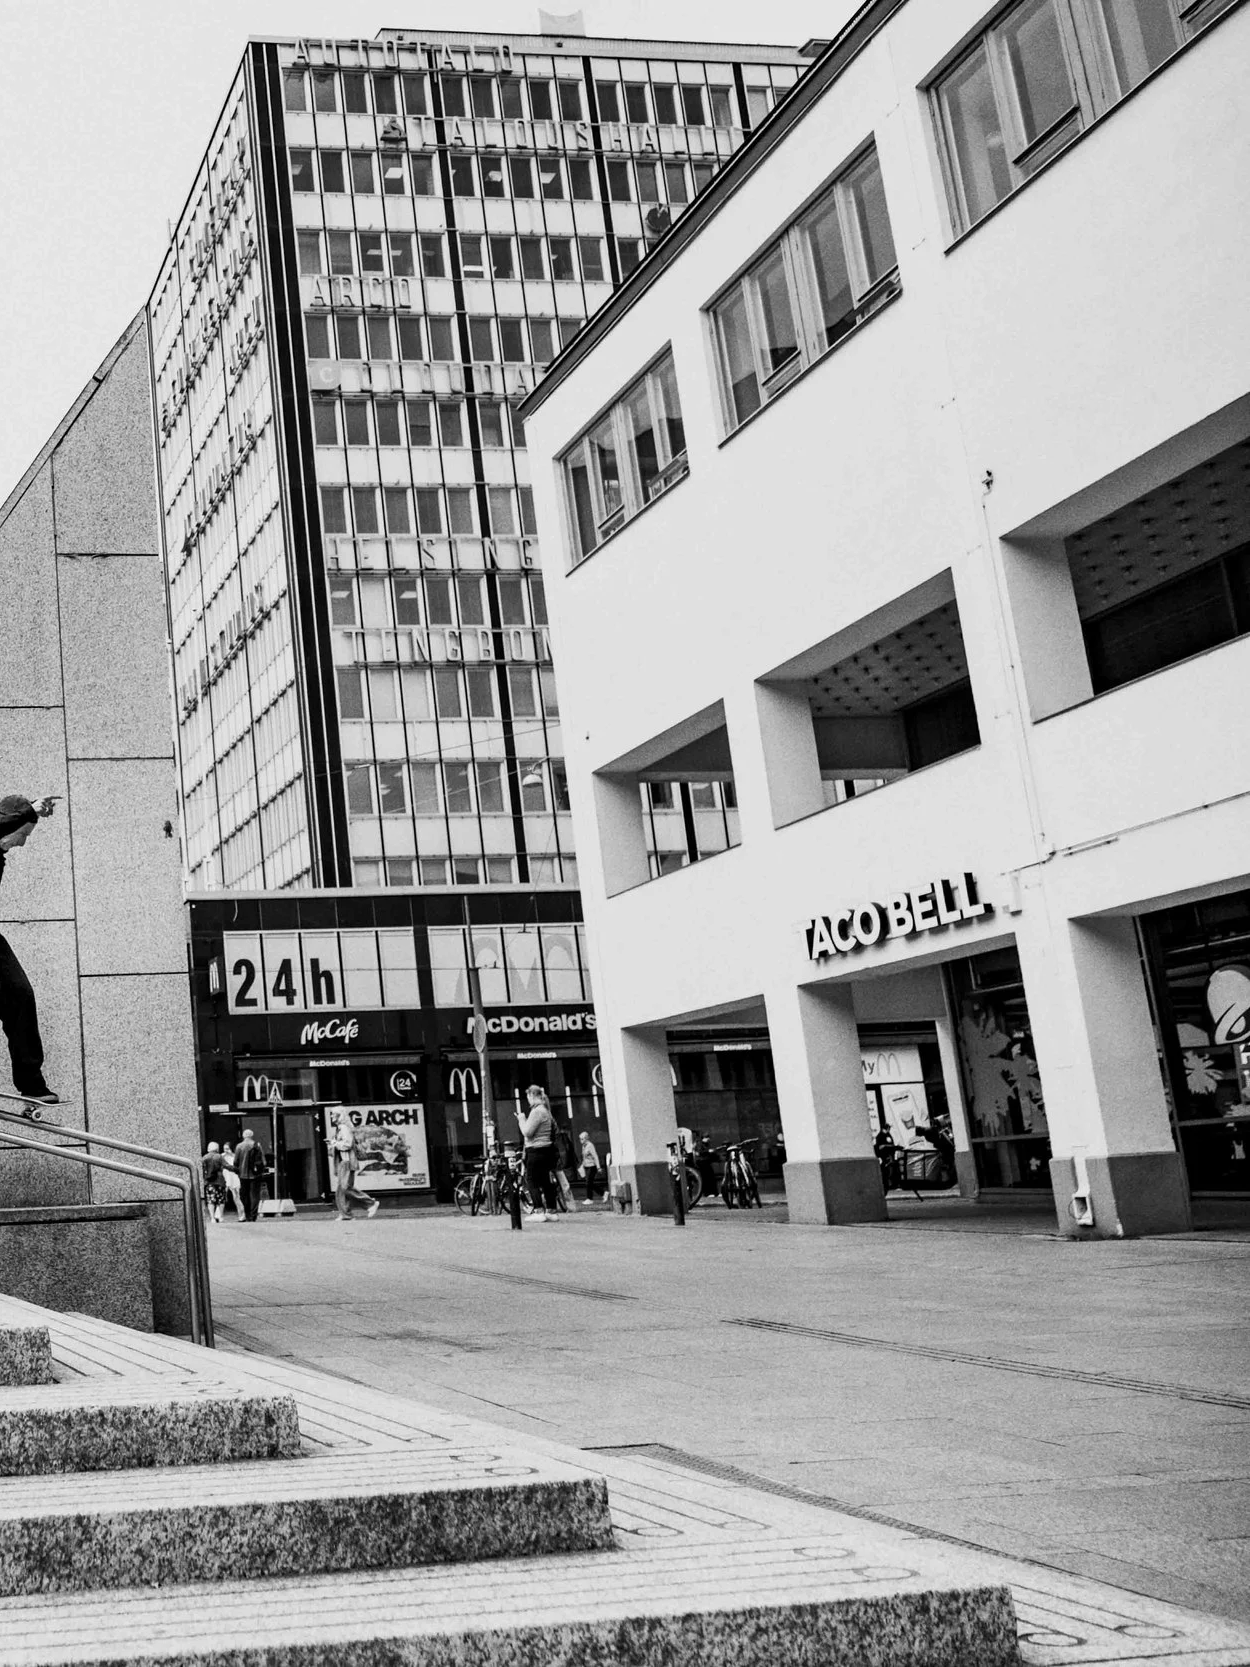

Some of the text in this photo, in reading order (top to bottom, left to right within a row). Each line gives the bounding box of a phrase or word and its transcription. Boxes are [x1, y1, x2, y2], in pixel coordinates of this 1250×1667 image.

[885, 872, 987, 938] BELL
[300, 1018, 359, 1045] McCafé
[365, 1109, 419, 1127] ARCH
